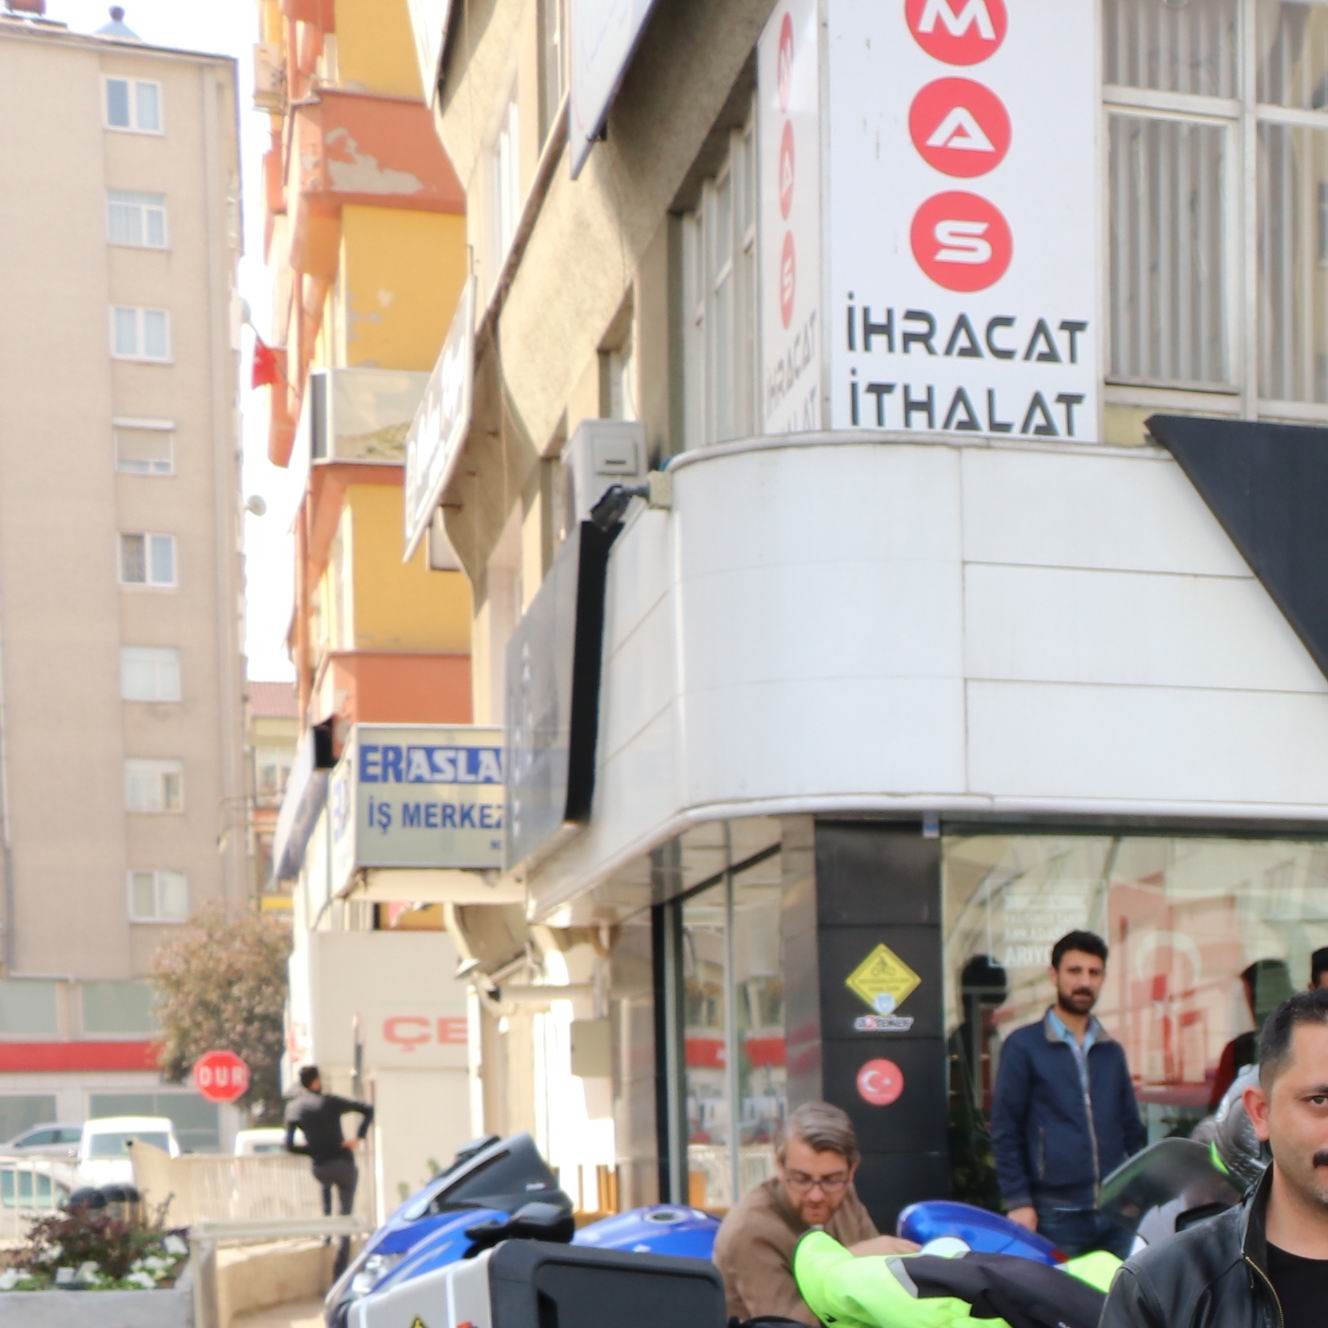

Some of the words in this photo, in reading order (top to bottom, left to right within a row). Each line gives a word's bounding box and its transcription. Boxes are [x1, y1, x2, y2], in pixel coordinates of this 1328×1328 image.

[845, 291, 1089, 365] İHRACAT
[849, 367, 1086, 437] İTHALAT
[367, 795, 392, 836] İŞ
[200, 1064, 244, 1088] DUR
